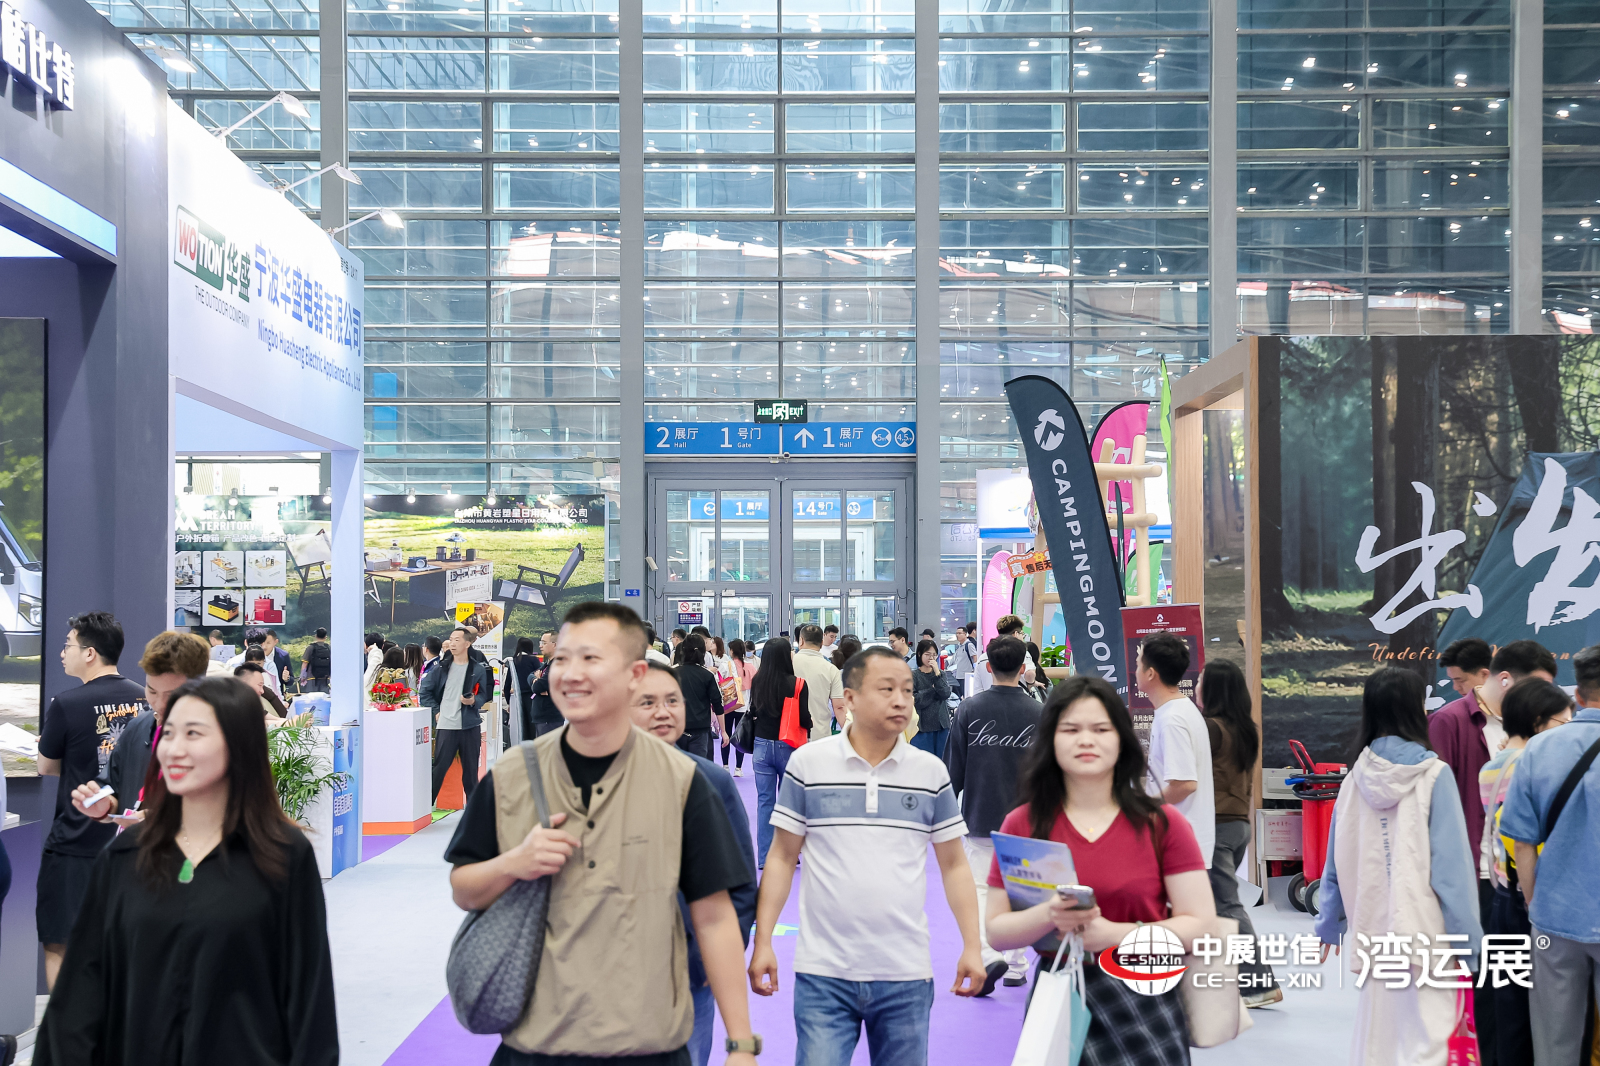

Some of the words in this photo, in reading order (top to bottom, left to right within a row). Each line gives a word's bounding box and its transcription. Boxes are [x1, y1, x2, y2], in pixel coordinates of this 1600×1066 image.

[227, 241, 250, 303] 华盛
[255, 240, 361, 357] 宁波华盛电器有限公司
[258, 318, 278, 352] Ningbo
[279, 331, 305, 369] Huasheng
[305, 345, 323, 373] Electric
[323, 355, 345, 383] Appliance
[789, 406, 804, 416] EXIT
[656, 426, 670, 448] 2
[674, 428, 699, 440] 展厅
[720, 427, 733, 448] 1
[737, 428, 762, 440] 号门
[822, 427, 835, 448] 1
[839, 428, 864, 440] 展厅
[735, 501, 745, 516] 1
[746, 501, 763, 511] 展厅
[796, 501, 816, 516] 14
[817, 501, 834, 511] 号门
[200, 521, 255, 531] TERRITORY
[1051, 458, 1118, 683] CAMPINGMOON
